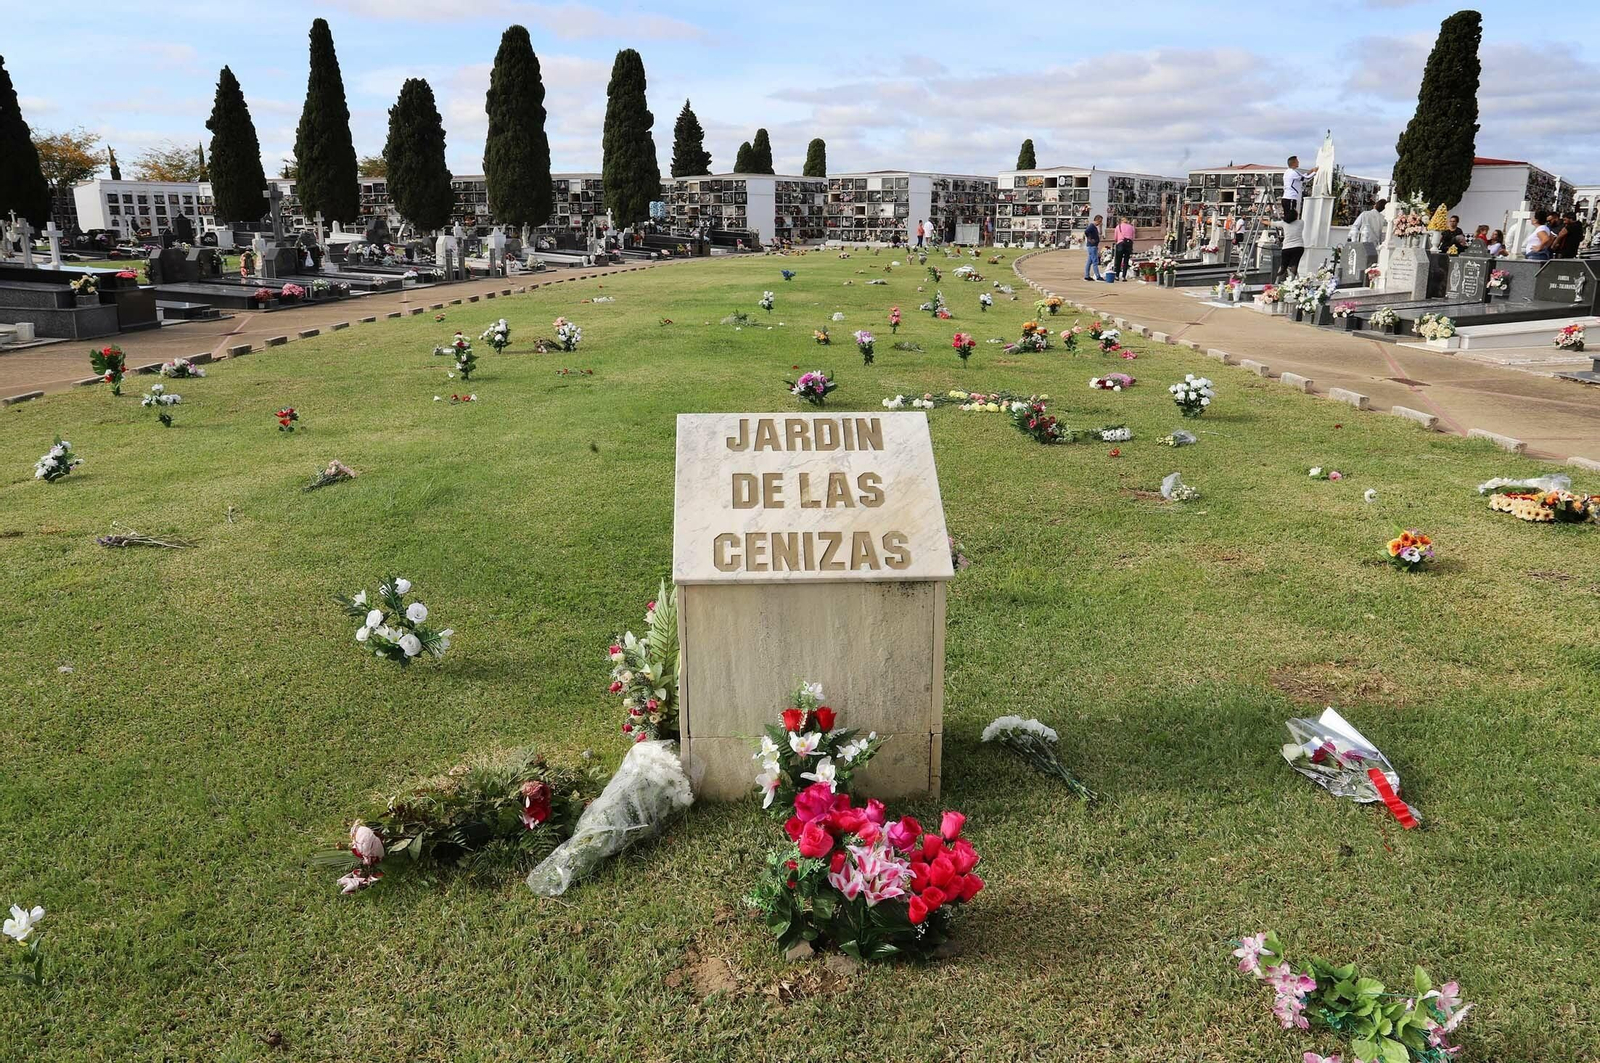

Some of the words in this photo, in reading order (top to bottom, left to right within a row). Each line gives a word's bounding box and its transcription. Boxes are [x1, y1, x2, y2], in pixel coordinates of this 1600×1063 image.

[726, 418, 884, 452] JARDIN
[732, 472, 785, 509] DE
[799, 472, 885, 508] LAS
[713, 531, 913, 573] CENIZAS
